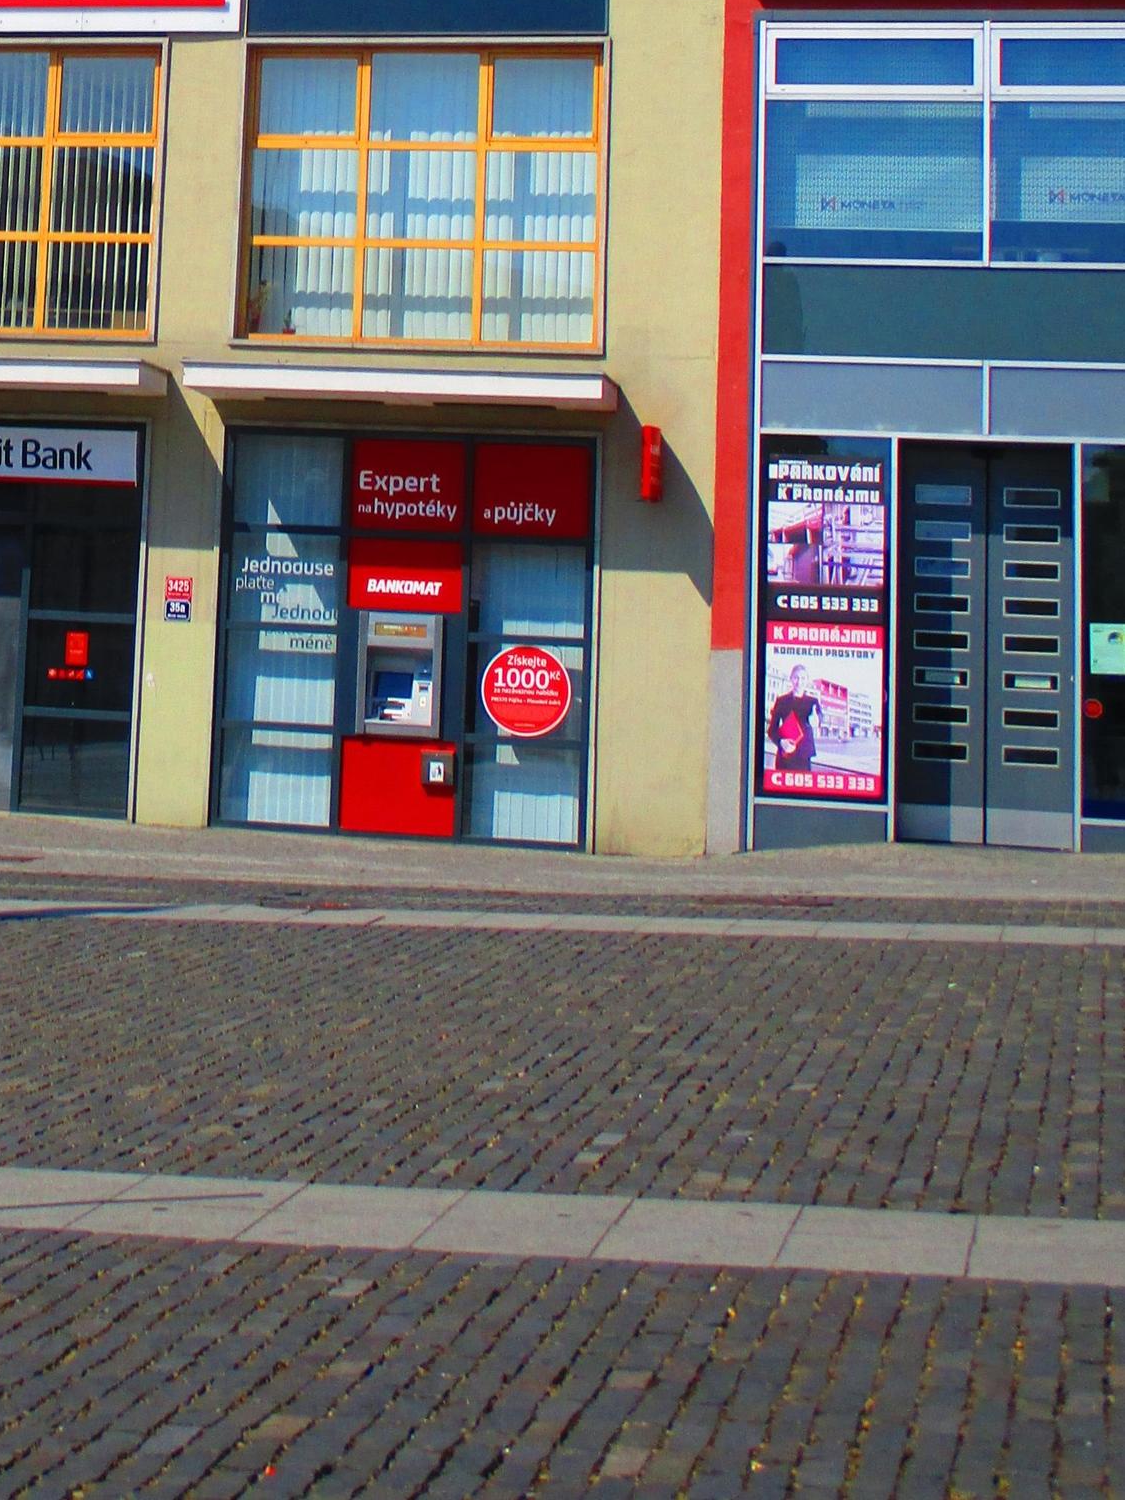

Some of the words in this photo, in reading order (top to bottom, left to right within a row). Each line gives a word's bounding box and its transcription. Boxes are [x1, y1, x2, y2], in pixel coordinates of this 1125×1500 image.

[22, 439, 93, 471] Bank
[359, 470, 441, 496] Expert
[778, 462, 882, 483] PARKOVÁNÍ
[358, 503, 372, 514] na
[374, 497, 457, 522] hypotéky
[483, 508, 491, 520] a
[494, 501, 557, 526] půjčky
[168, 579, 190, 593] 3425
[367, 578, 443, 596] BANKOMAT
[507, 654, 547, 669] Získejte
[494, 667, 550, 690] 1000
[550, 670, 561, 681] Kč
